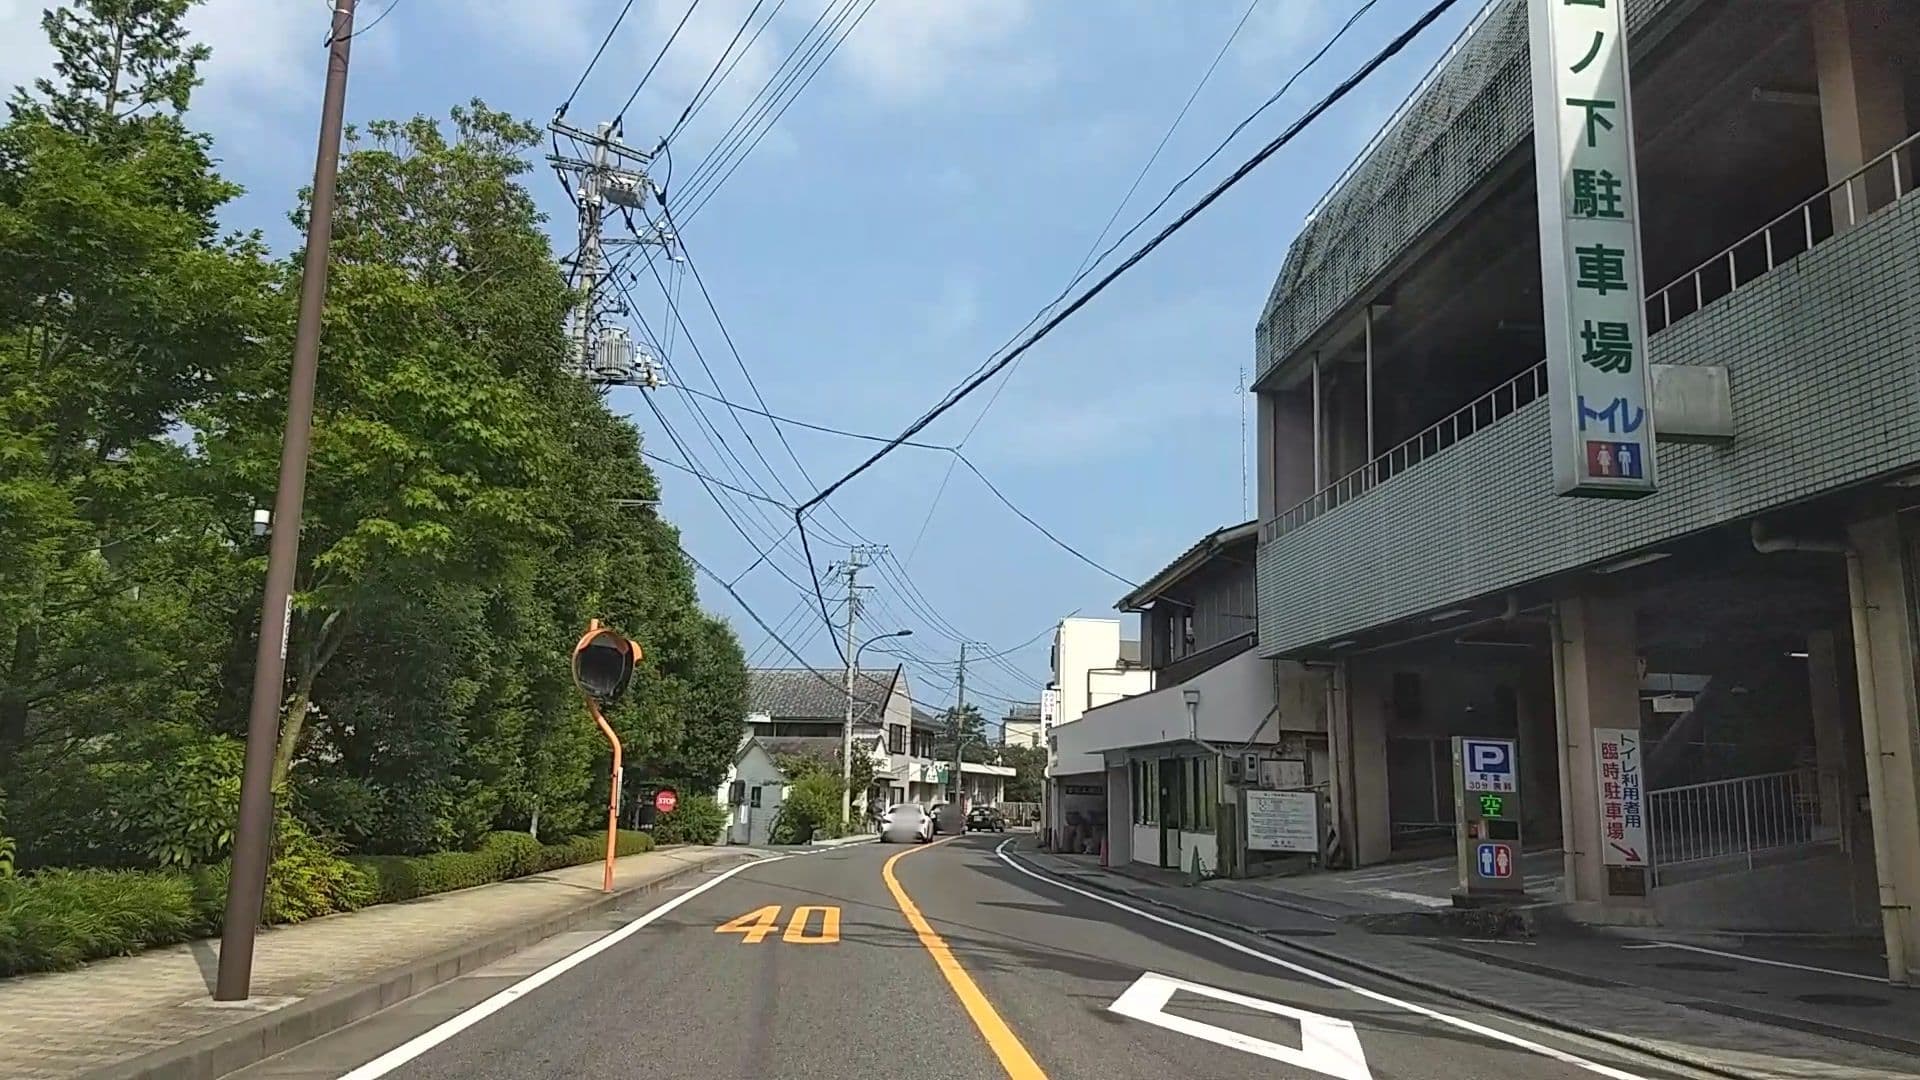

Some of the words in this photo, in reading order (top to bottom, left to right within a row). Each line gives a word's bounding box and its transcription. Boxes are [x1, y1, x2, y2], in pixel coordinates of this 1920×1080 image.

[1564, 0, 1634, 374] ノ下駐車場
[1577, 395, 1644, 434] トイレ
[1474, 745, 1505, 771] P
[1601, 743, 1625, 840] 臨時駐車場
[1620, 734, 1641, 829] トイレ利用者用
[1480, 795, 1502, 817] 空
[714, 905, 841, 945] 40
